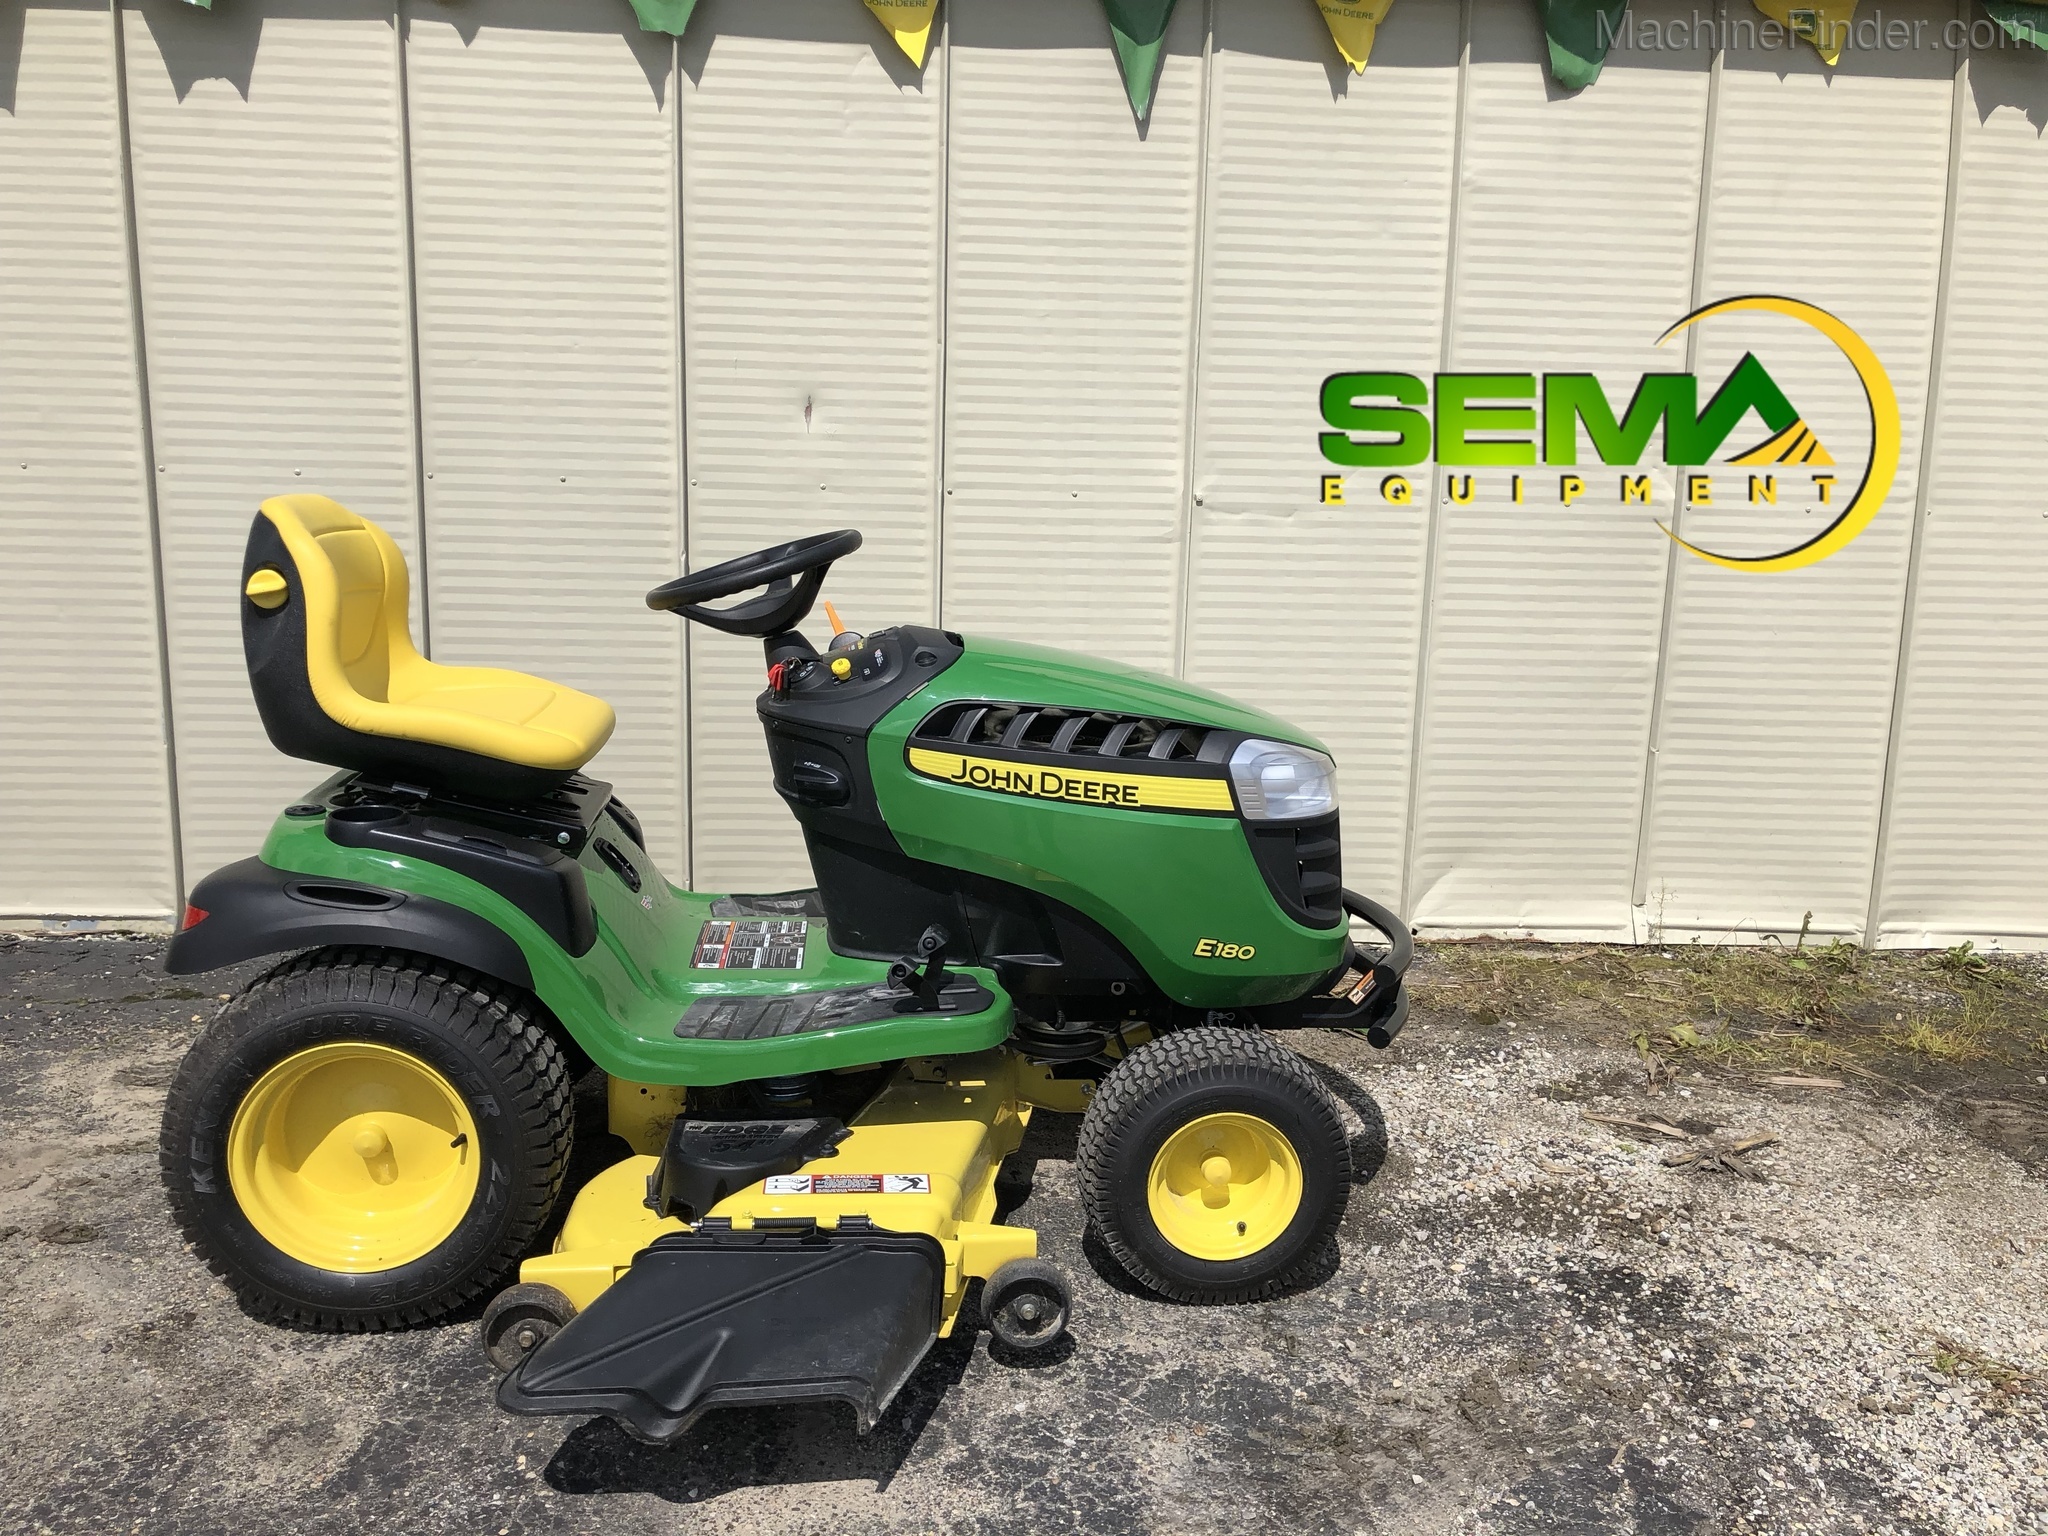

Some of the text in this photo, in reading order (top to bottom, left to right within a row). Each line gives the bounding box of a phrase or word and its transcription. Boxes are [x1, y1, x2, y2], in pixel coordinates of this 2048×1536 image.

[1321, 4, 1374, 20] JOHN DEERE
[951, 759, 1140, 804] JOHN DEERE
[1193, 937, 1256, 961] E180
[275, 1013, 501, 1119] TURF RIDER
[700, 1124, 790, 1134] EDGE
